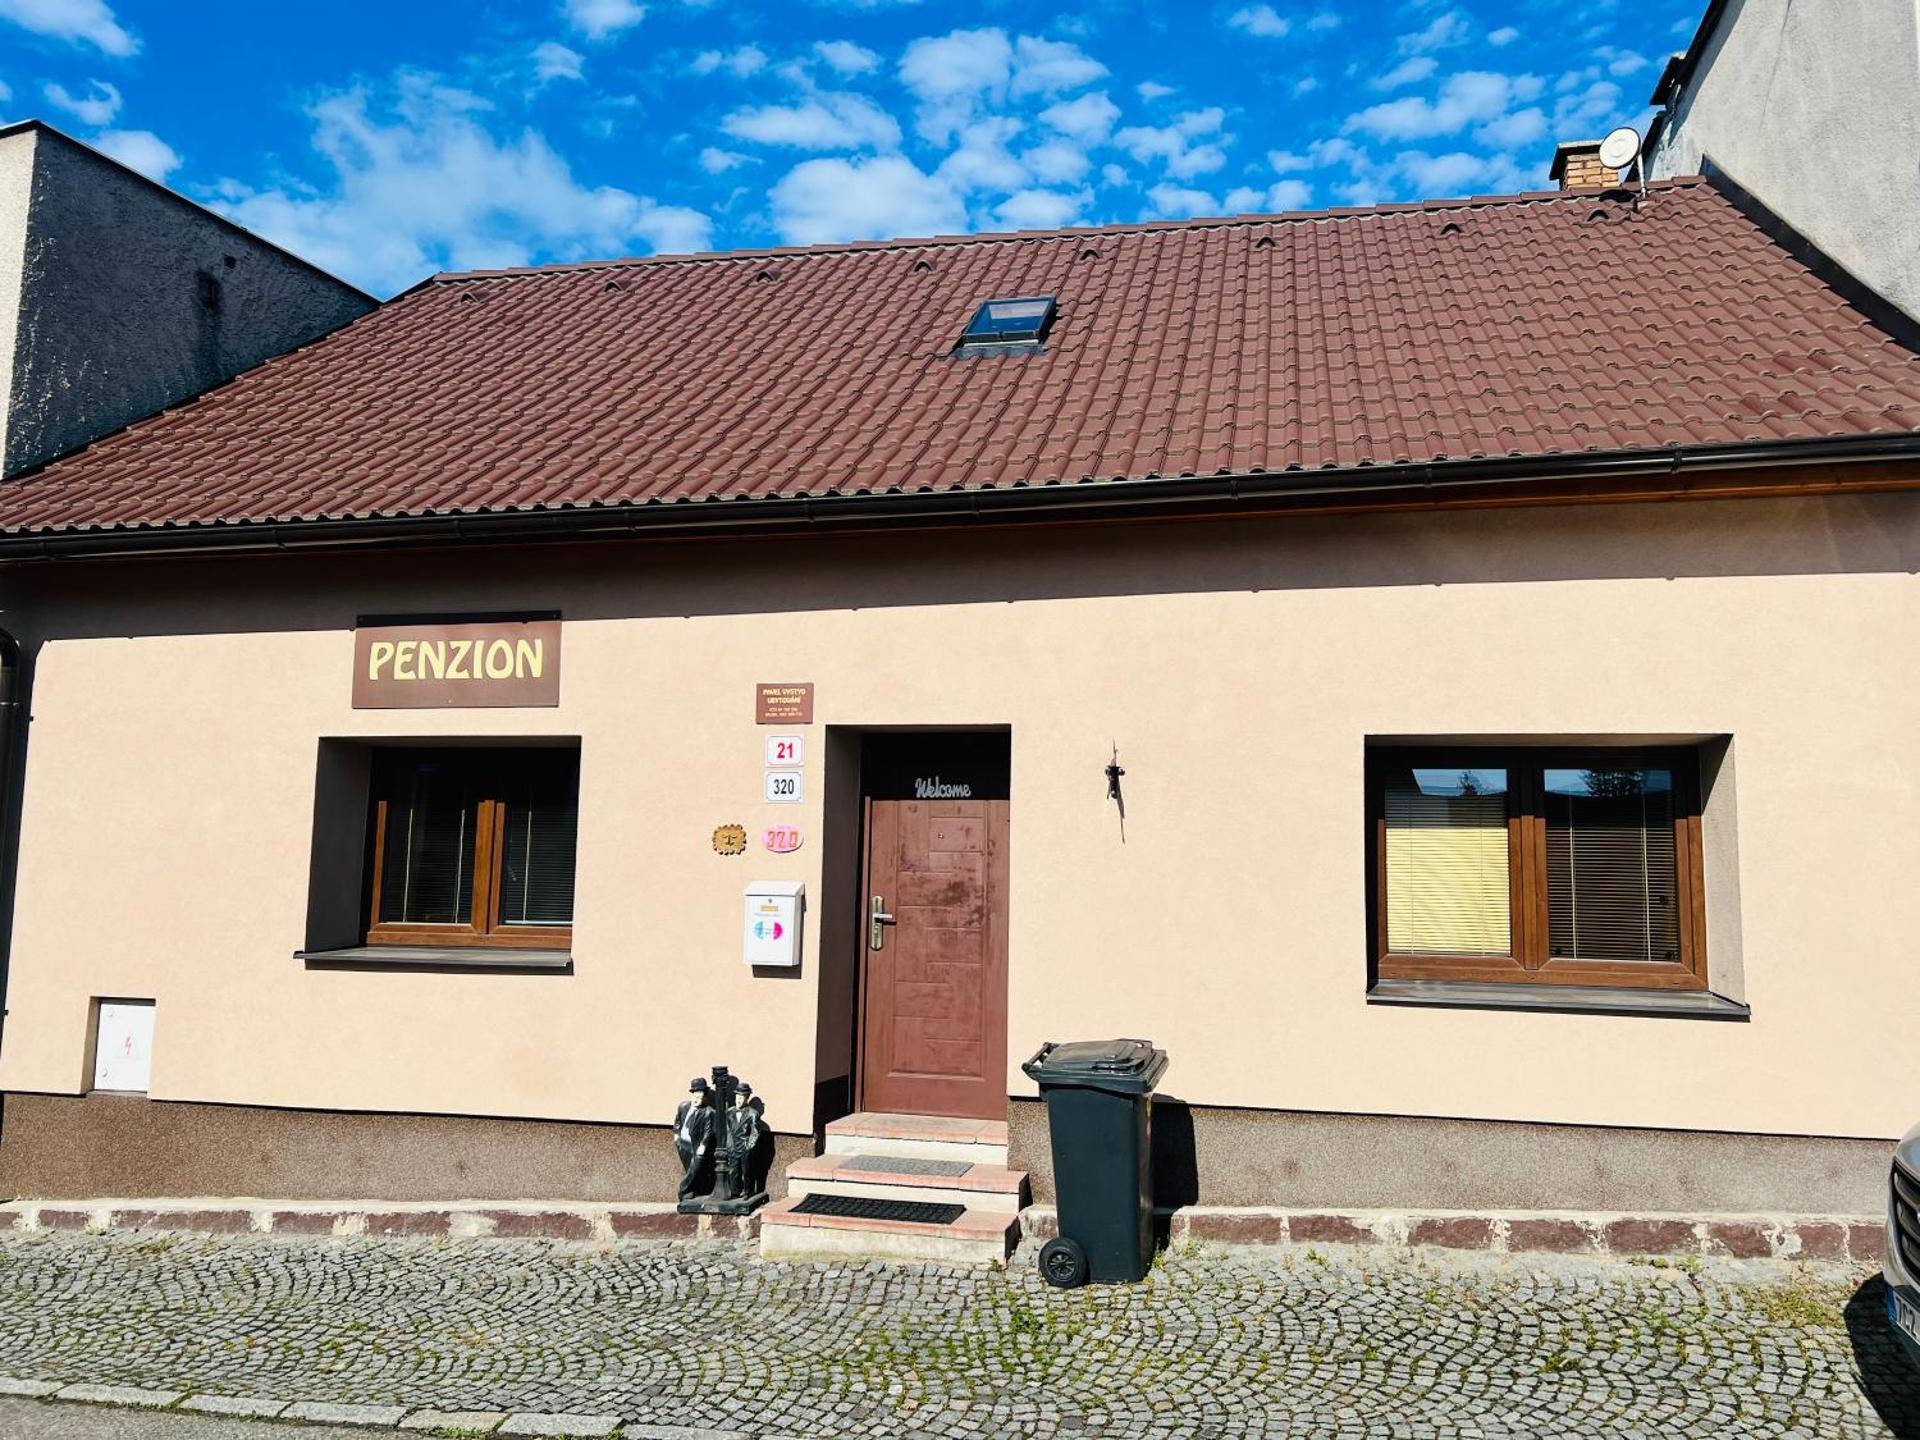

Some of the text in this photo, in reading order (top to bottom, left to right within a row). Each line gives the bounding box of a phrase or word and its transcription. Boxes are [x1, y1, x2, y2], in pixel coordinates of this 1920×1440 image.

[369, 638, 544, 681] PENZION
[776, 742, 794, 759] 21
[773, 778, 795, 795] 320
[914, 775, 972, 798] Welcome
[767, 830, 799, 849] 320
